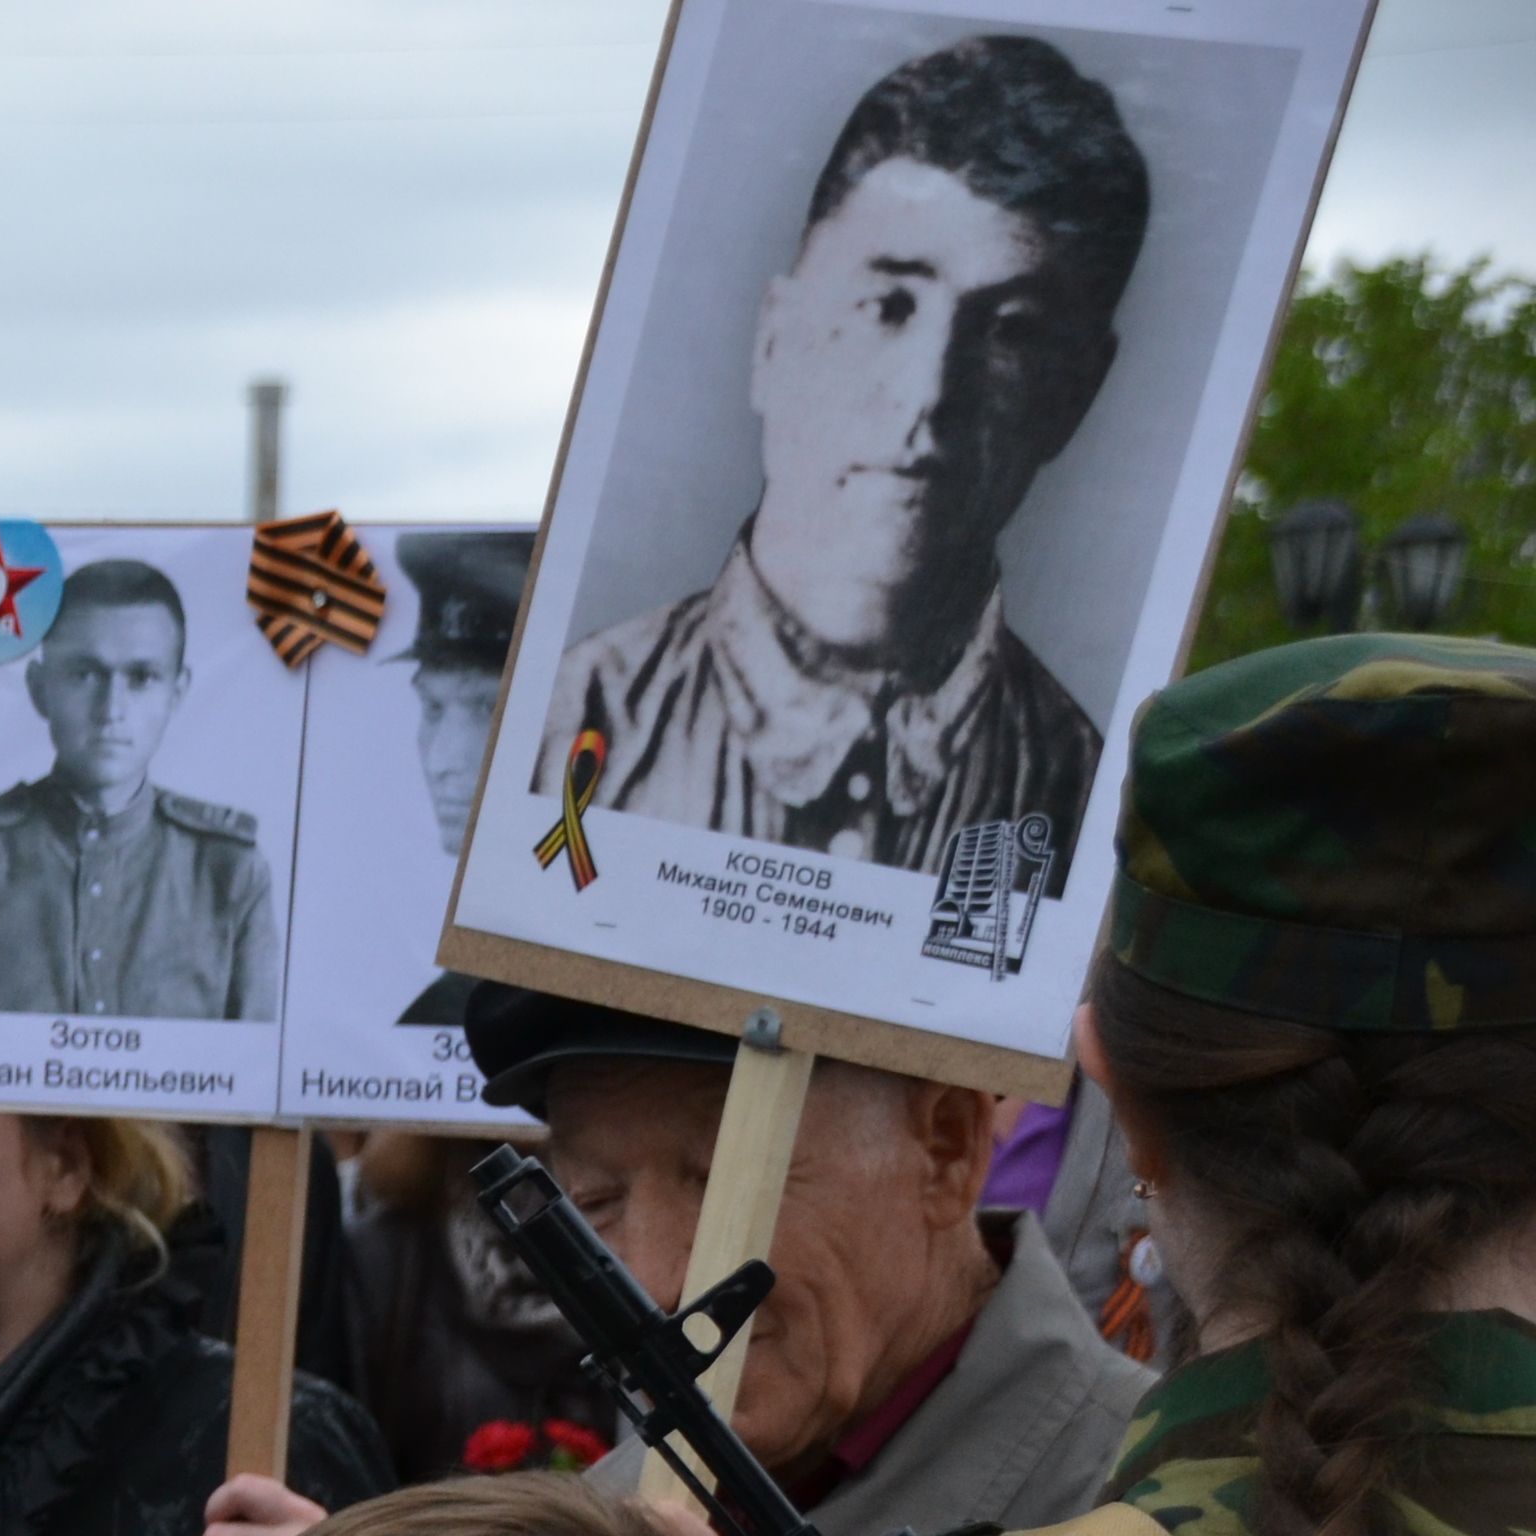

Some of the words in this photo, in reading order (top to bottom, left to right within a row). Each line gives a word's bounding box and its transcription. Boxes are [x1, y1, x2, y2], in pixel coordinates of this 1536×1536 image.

[726, 851, 833, 890] КОБЛОВ
[657, 861, 747, 896] Михаил
[755, 884, 894, 927] Семенович
[701, 896, 756, 924] 1900
[782, 914, 837, 941] 1944
[50, 1020, 142, 1052] Зотов
[43, 1061, 235, 1094] Васильевич
[302, 1069, 444, 1100] Николай
